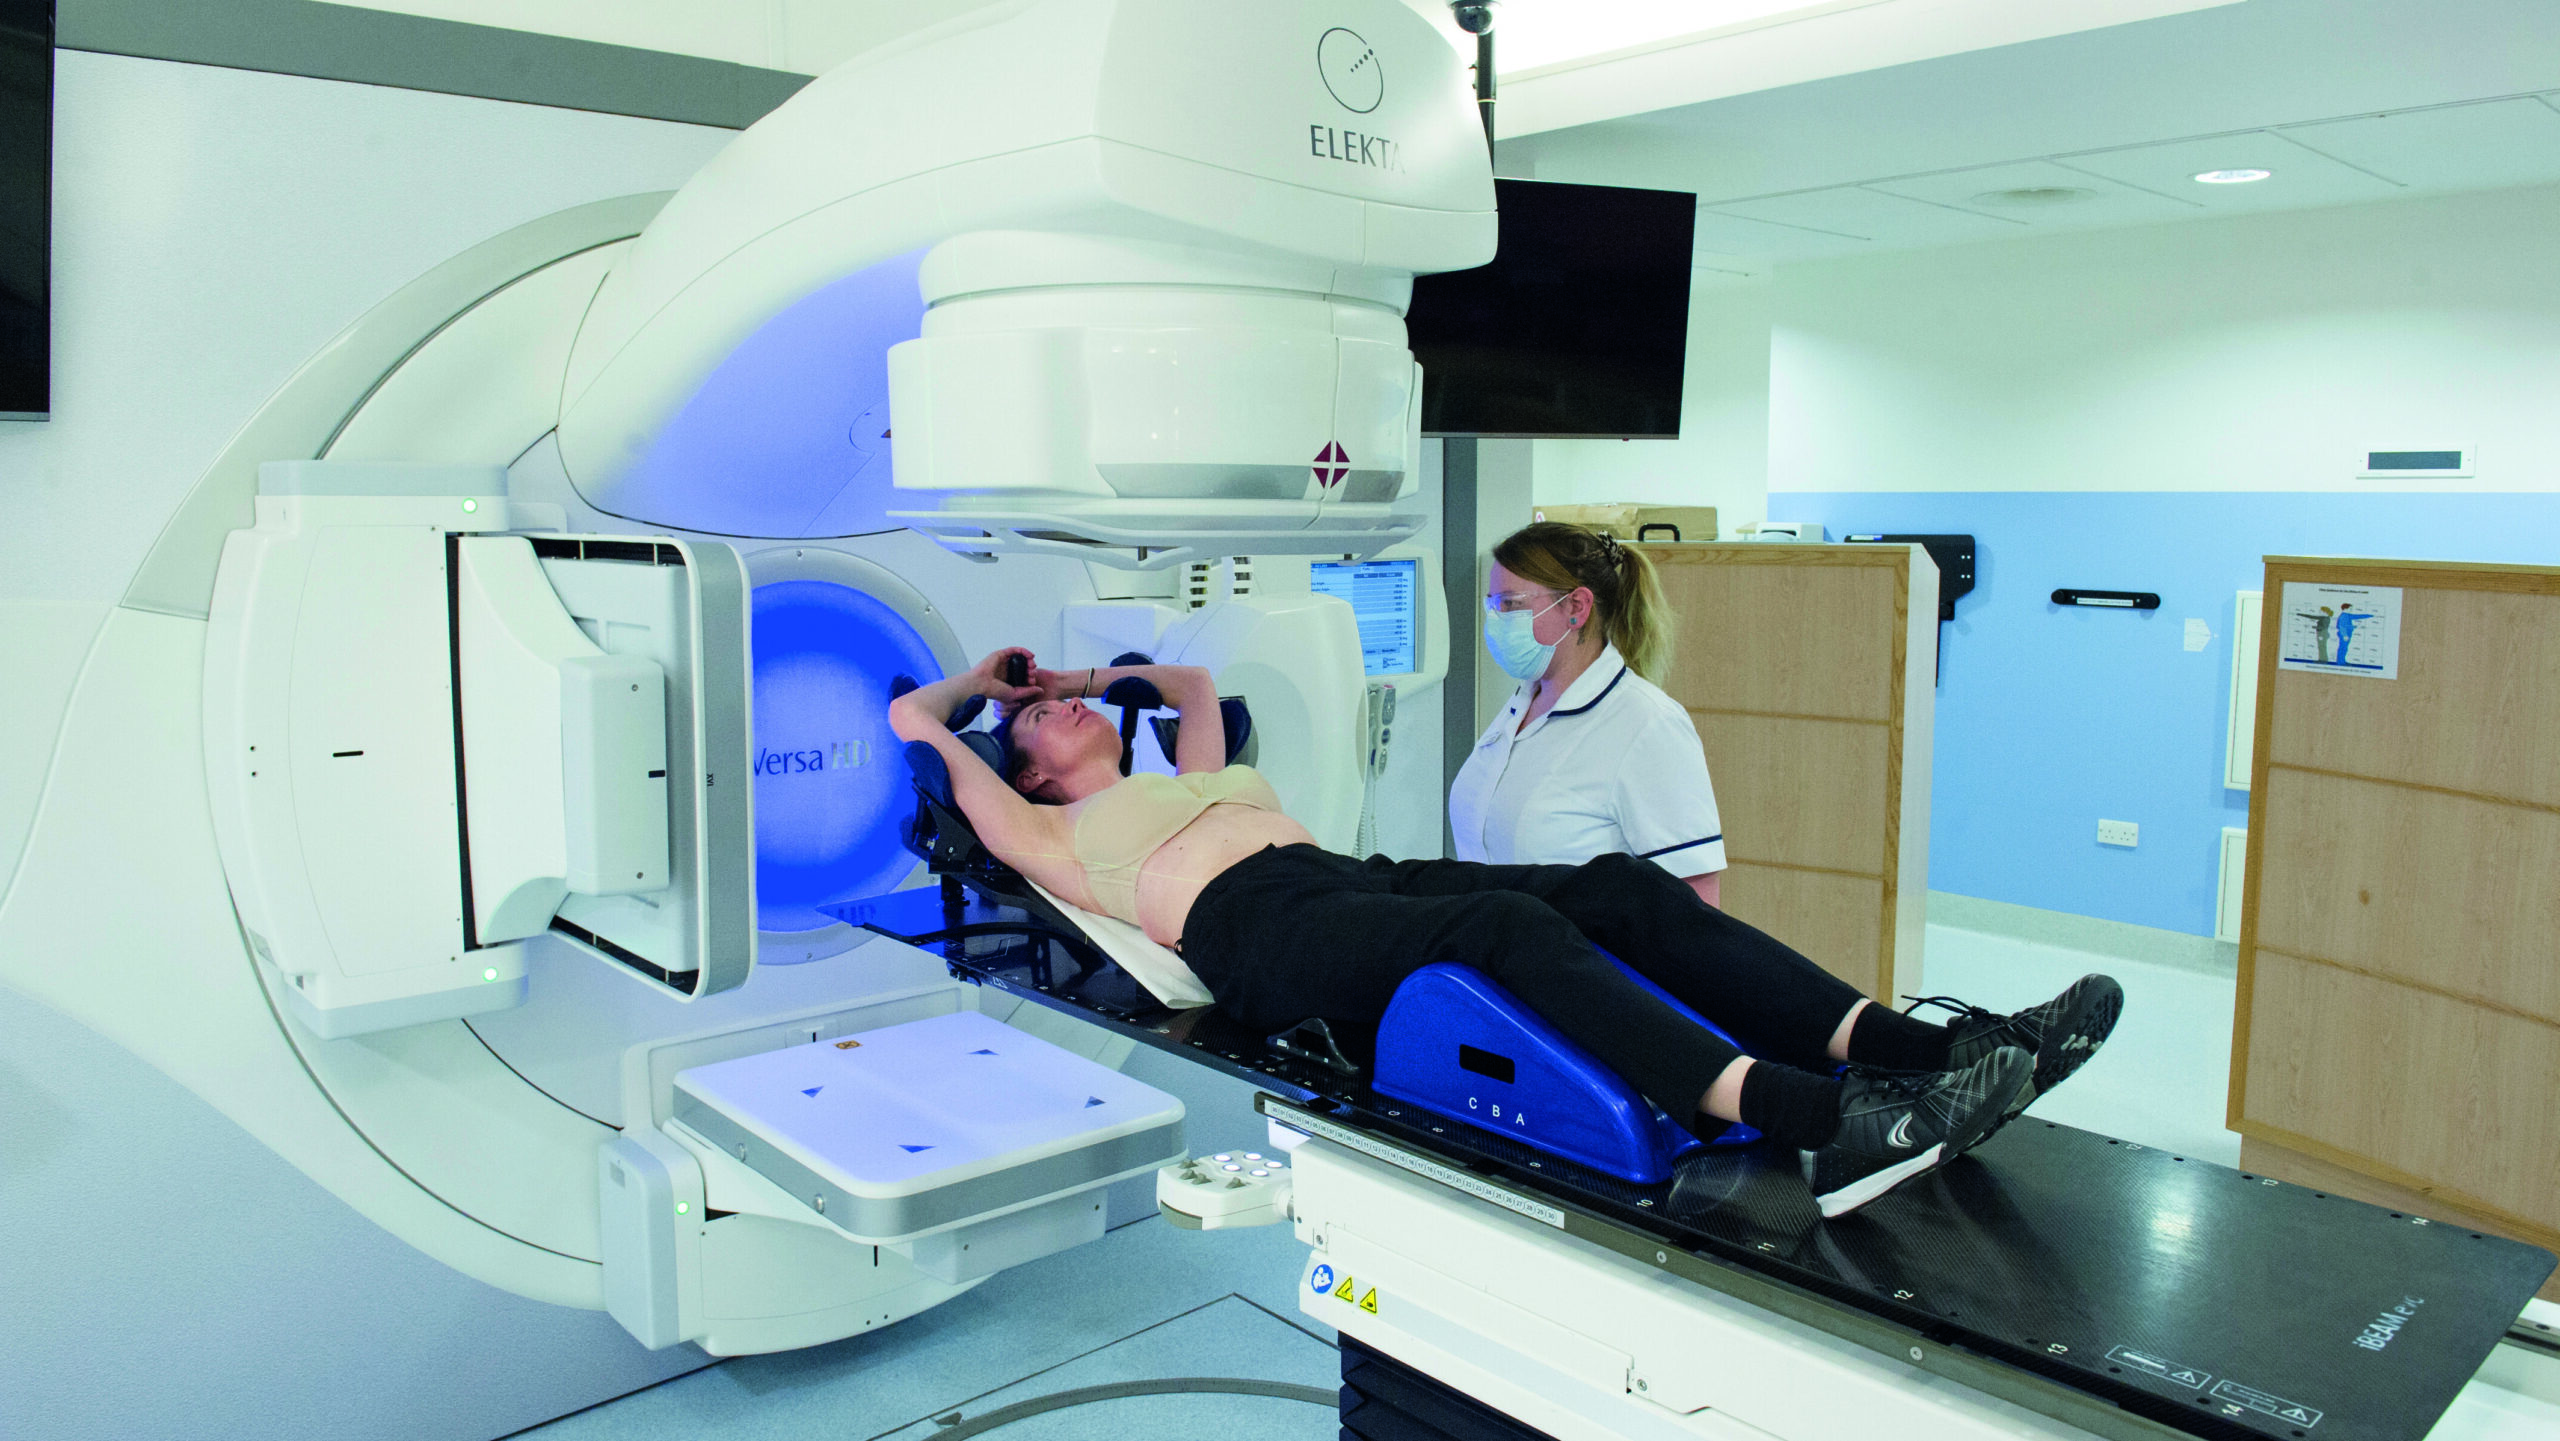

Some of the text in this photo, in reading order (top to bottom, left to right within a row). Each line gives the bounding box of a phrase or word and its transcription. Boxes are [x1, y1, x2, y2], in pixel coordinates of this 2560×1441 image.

[1310, 124, 1406, 174] ELEKTA
[754, 740, 870, 776] Versa HD
[1468, 1096, 1525, 1127] C B A
[1637, 1199, 1654, 1208] 10
[1757, 1242, 1775, 1251] 11
[1894, 1289, 1914, 1300] 12
[2352, 1312, 2408, 1351] iBEAM
[2047, 1343, 2069, 1355] 13
[2221, 1403, 2244, 1416] 14
